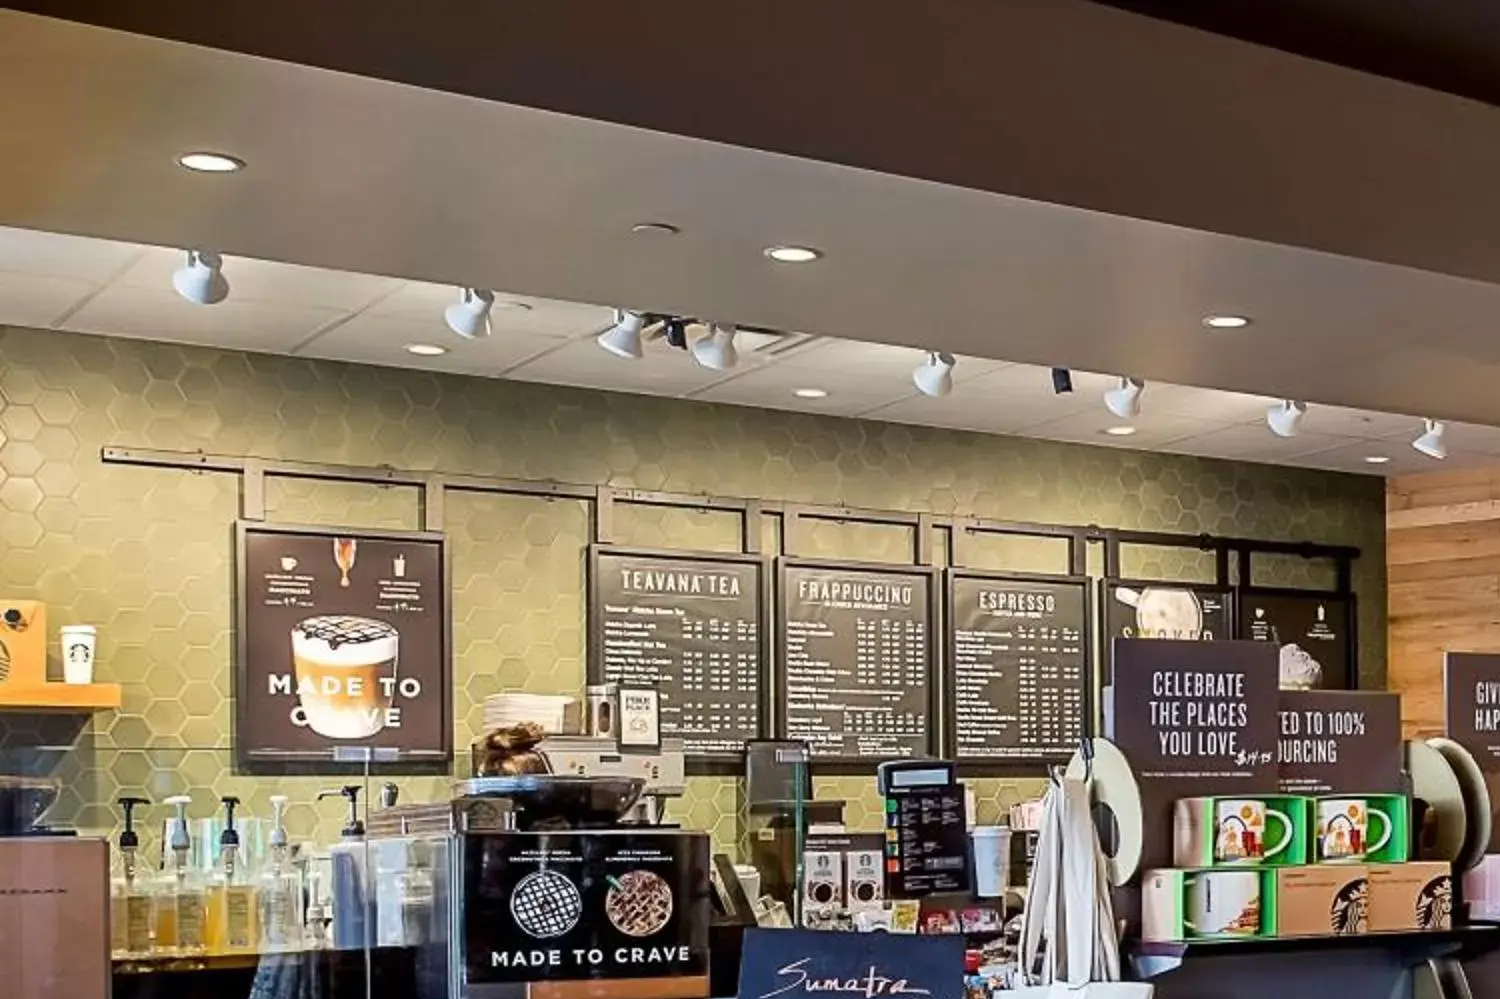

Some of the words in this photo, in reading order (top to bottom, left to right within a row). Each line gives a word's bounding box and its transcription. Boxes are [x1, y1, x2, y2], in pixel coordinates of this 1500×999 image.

[708, 575, 740, 595] TEA
[799, 580, 912, 605] FRAPPUCCINO
[979, 591, 1055, 613] ESPRESSO
[268, 673, 364, 696] MADE
[379, 676, 421, 697] TO
[1153, 671, 1245, 697] CELEBRATE
[1149, 701, 1180, 727] THE
[1187, 702, 1248, 728] PLACES
[1304, 712, 1324, 735] TO
[1327, 711, 1365, 736] 100%
[1159, 731, 1191, 756] YOU
[1199, 731, 1237, 756] LOVE
[491, 950, 561, 968] MADE
[572, 949, 604, 965] TO
[615, 946, 690, 963] CRAVE
[759, 957, 931, 999] Sumatra
